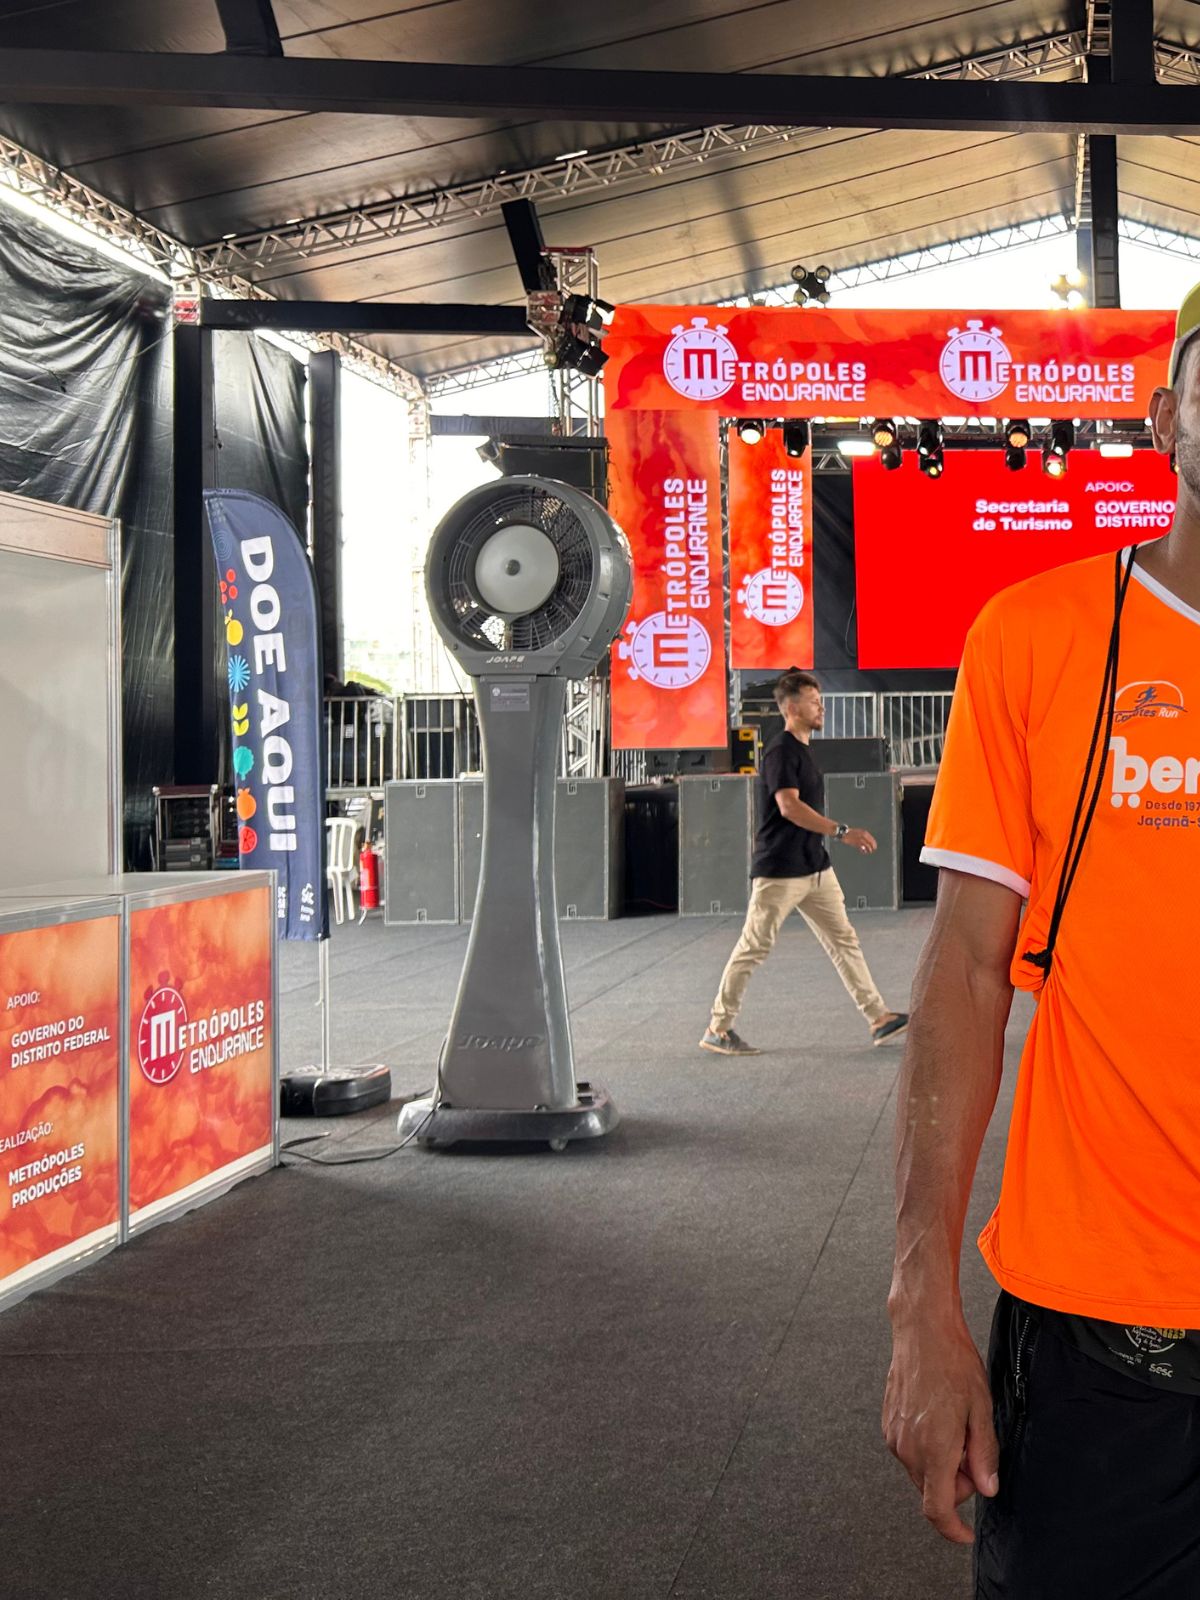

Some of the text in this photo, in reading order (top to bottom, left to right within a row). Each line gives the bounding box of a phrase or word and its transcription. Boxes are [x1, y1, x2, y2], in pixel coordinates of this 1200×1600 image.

[683, 348, 867, 383] METRÓPOLES
[959, 350, 1136, 383] METRÓPOLES
[742, 382, 867, 403] ENDURANCE
[1015, 384, 1135, 403] ENDURANCE
[1085, 482, 1134, 493] APOIO:
[788, 469, 804, 567] ENDURANCE
[975, 499, 1070, 514] Secretaria
[1095, 500, 1176, 514] GOVERNO
[1095, 515, 1170, 528] DISTRITO
[972, 517, 1073, 531] de Turismo
[688, 478, 709, 609] ENDURANCE
[240, 535, 298, 852] DOE AQUI
[1158, 707, 1179, 718] Run
[1145, 800, 1182, 811] Desde
[6, 991, 41, 1010] APOIO:
[11, 1015, 85, 1048] GOVERNO DO
[150, 1000, 265, 1061] METRÓPOLES
[11, 1027, 111, 1068] DISTRITO FEDERAL
[190, 1026, 265, 1074] ENDURANCE
[0, 1121, 54, 1153] EALIZAÇÃO:
[8, 1142, 85, 1186] METRÓPOLES
[12, 1165, 83, 1209] PRODUÇÕES
